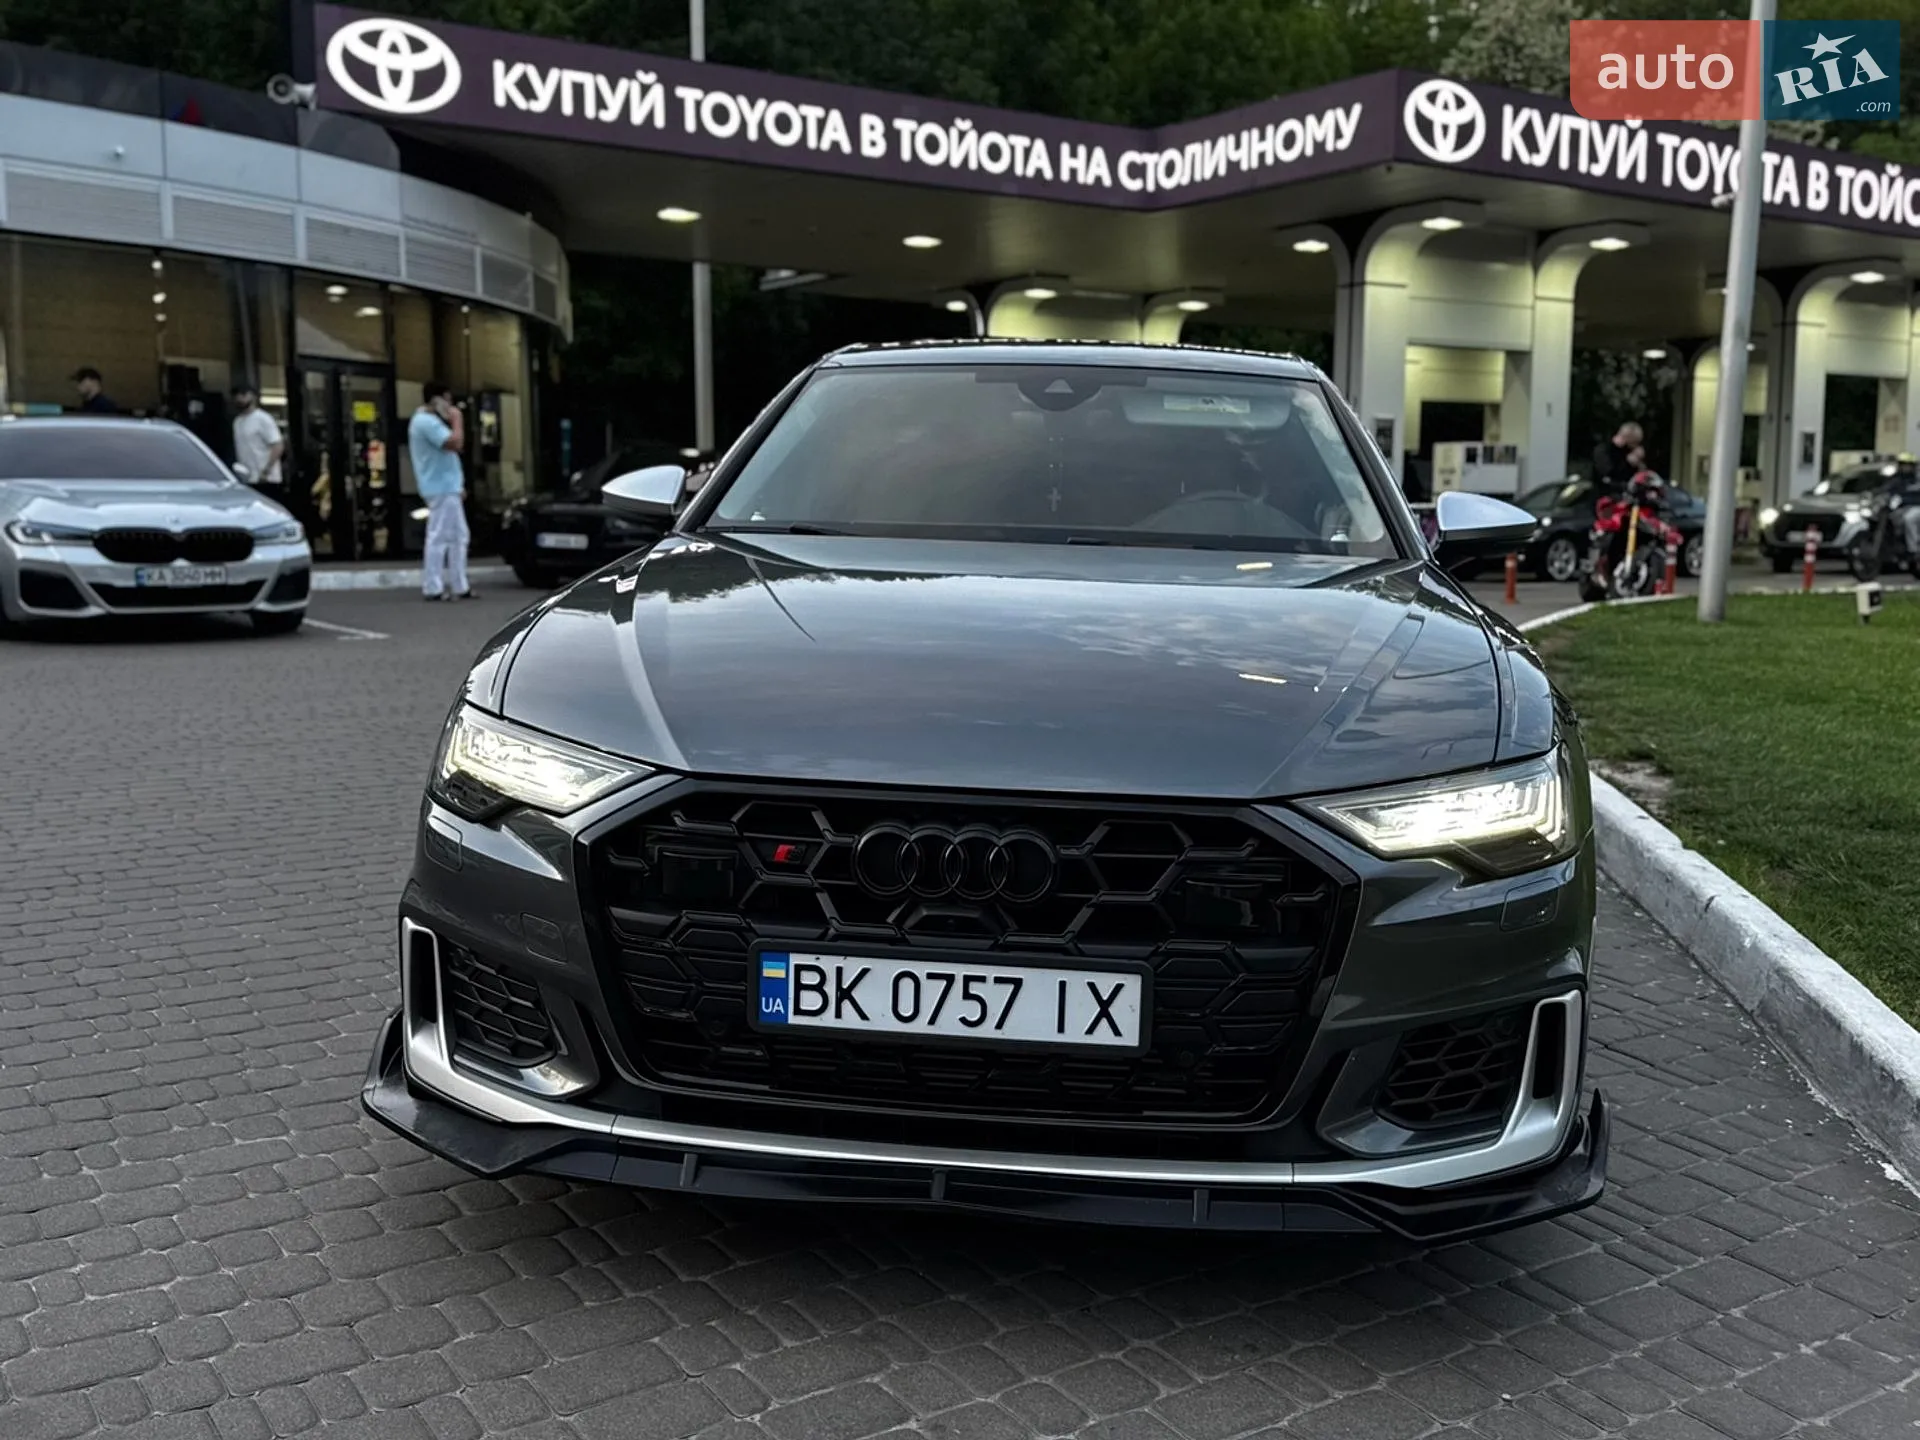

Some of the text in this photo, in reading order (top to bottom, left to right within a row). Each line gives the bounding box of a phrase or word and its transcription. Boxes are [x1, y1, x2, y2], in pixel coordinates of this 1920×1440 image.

[492, 59, 1363, 193] КУПУЙ TOYOTA В ТОЙОТА НА СТОЛИЧНОМУ
[1501, 104, 1648, 183] КУПУЙ
[1806, 160, 1829, 211] В
[761, 996, 785, 1014] UA
[793, 963, 1125, 1037] BK 0757 IX
